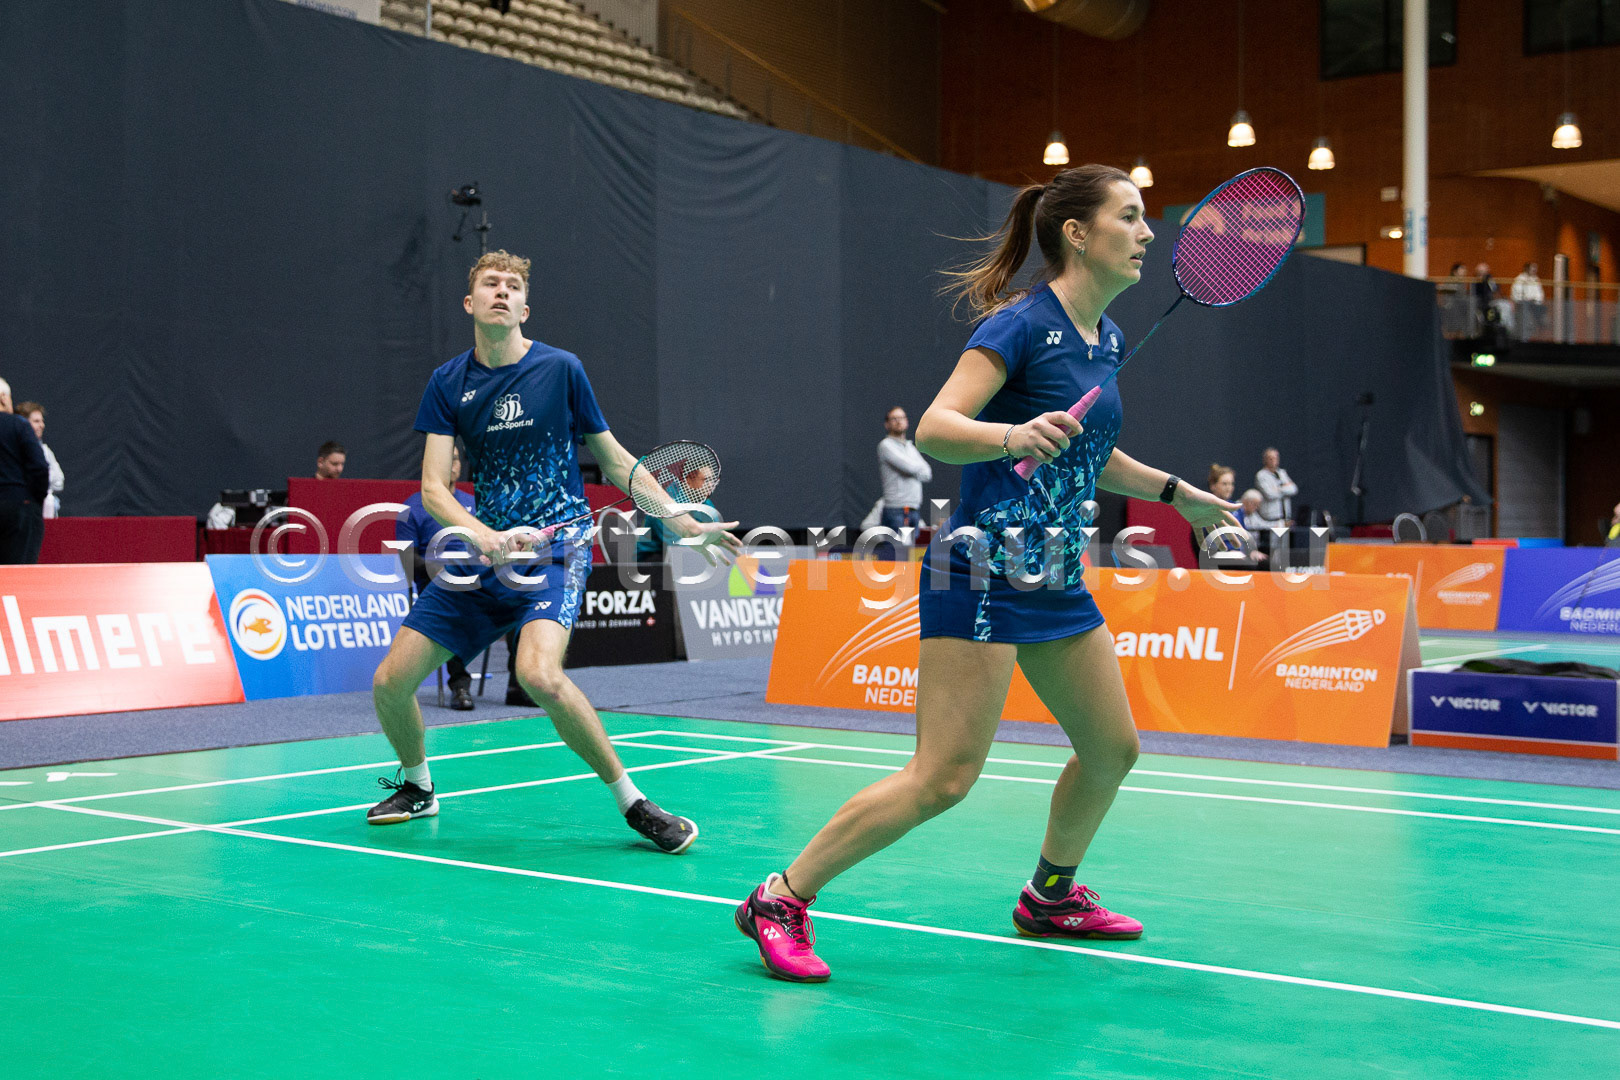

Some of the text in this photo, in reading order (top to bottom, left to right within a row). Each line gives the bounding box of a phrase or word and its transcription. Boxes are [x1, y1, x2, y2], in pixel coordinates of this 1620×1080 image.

[285, 593, 418, 621] NEDERLAND
[586, 590, 656, 616] FORZA
[290, 620, 392, 651] LOTERIJ
[1110, 625, 1224, 662] amNL
[1276, 664, 1378, 682] BADMINTON
[1285, 677, 1364, 693] NEDERLAND
[1448, 696, 1501, 712] VICTOR
[1541, 701, 1599, 717] VICTOR
